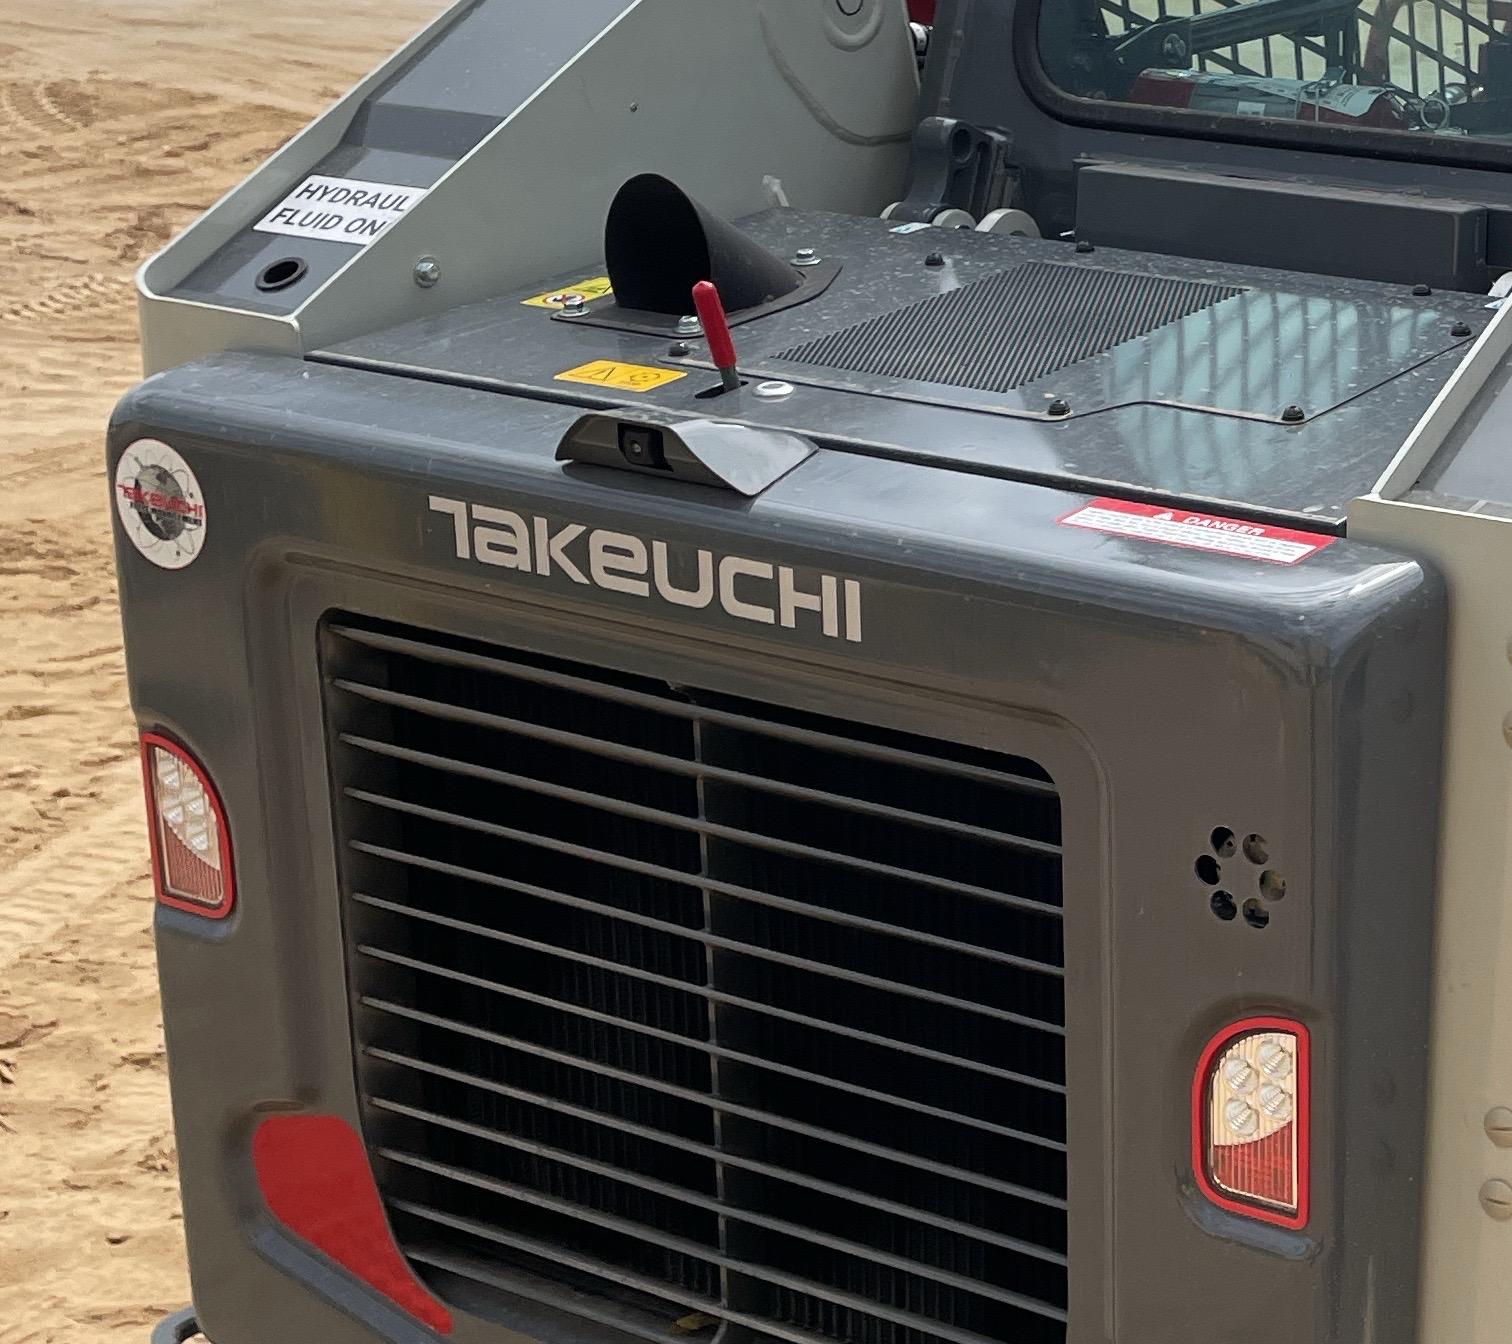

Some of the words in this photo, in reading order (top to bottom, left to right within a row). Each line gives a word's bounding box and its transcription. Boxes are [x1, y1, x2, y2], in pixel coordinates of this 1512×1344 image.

[295, 182, 410, 212] HYDRAUL
[269, 207, 343, 230] FLUID
[344, 217, 388, 236] ON
[1180, 516, 1266, 536] DANGER
